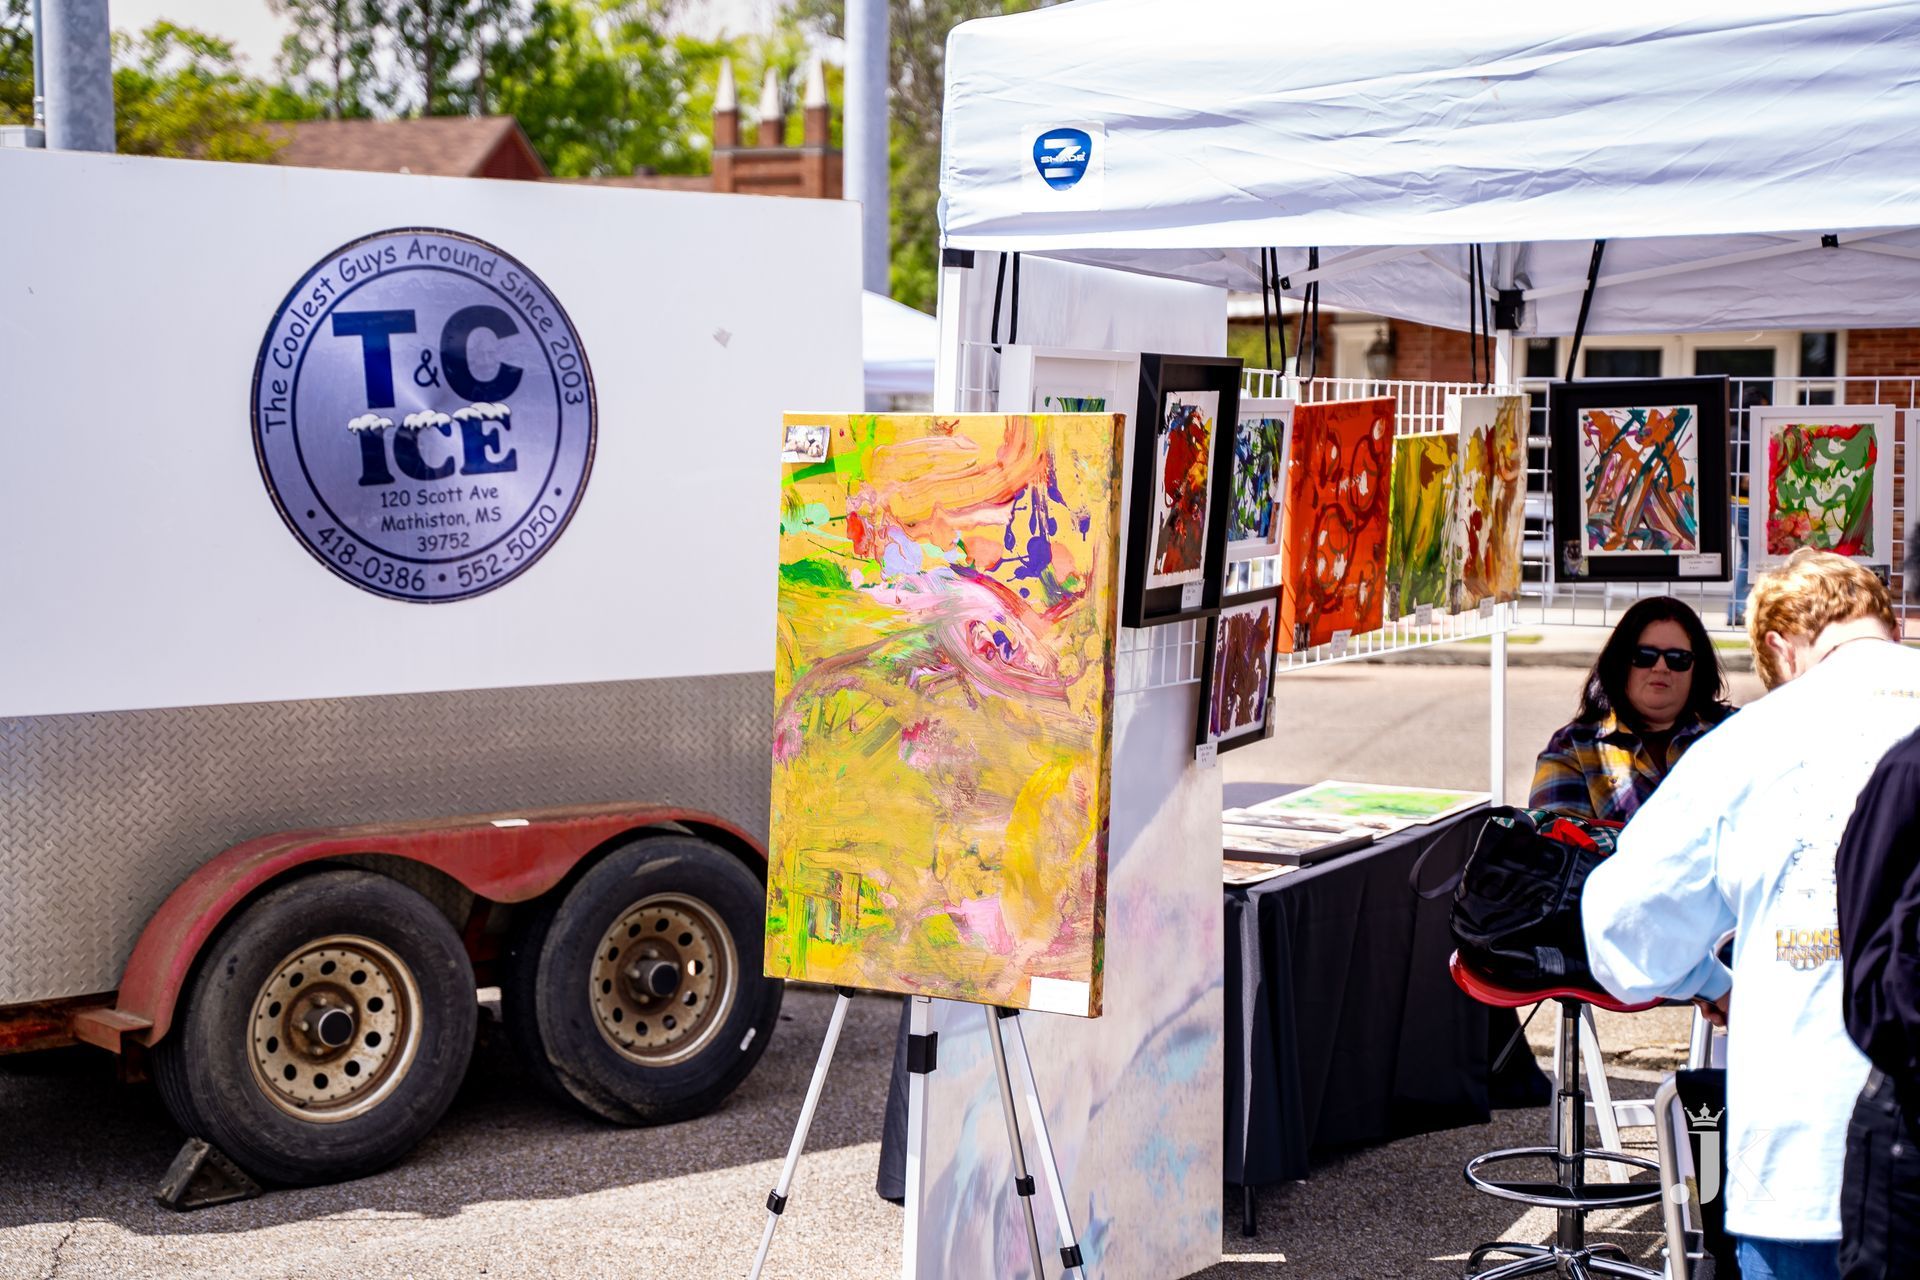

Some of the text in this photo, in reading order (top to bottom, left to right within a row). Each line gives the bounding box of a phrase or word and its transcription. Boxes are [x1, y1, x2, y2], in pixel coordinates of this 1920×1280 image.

[265, 238, 584, 433] The Coolest Guys Around Since 2003
[350, 405, 518, 487] ICE
[380, 485, 499, 508] 120 Scott Ave
[380, 506, 503, 532] Mathiston, MS
[317, 526, 426, 591] 418-0386
[416, 532, 471, 552] 39752
[457, 504, 558, 588] 552-5050
[1776, 928, 1840, 947] LIONS
